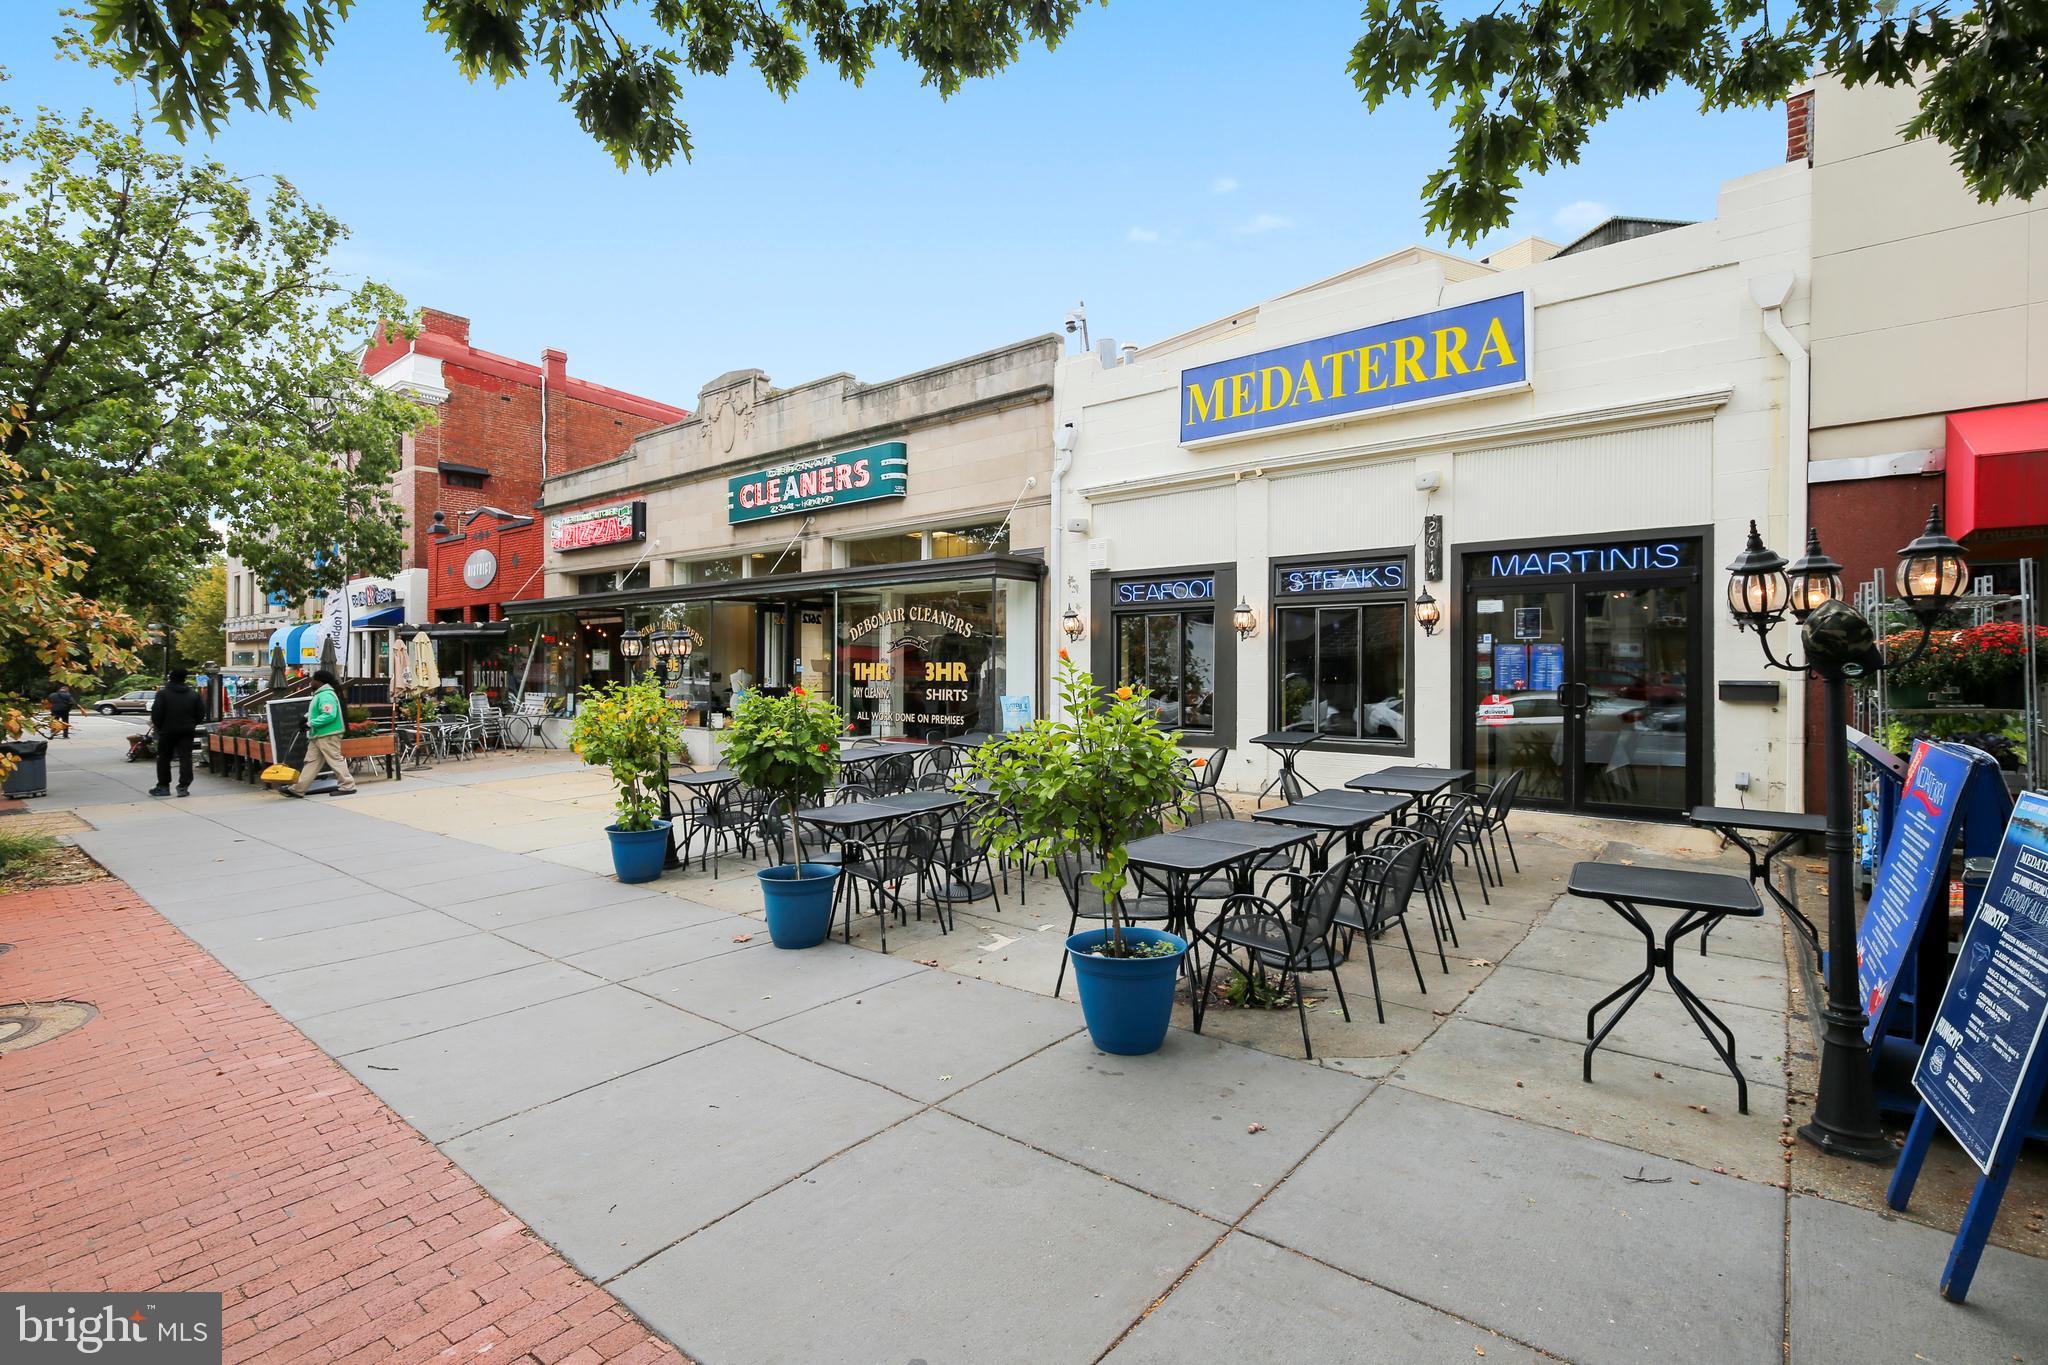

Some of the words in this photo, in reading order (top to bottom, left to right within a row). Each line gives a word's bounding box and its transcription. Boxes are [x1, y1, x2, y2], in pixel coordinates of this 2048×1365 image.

[1185, 317, 1518, 426] MEDATERRA
[740, 459, 871, 509] CLEANERS
[561, 517, 619, 549] PIZZA
[1427, 520, 1437, 577] 2614
[467, 561, 492, 577] DISTRICT
[1491, 544, 1680, 577] MARTINIS
[1288, 566, 1402, 592] STEAKS
[849, 607, 905, 642] DEBONAIR
[909, 606, 974, 638] CLEANERS
[473, 670, 508, 687] DISTRICT
[853, 662, 891, 680] 1HR
[925, 662, 968, 682] 3HR
[853, 686, 864, 698] DRY
[864, 687, 890, 699] CLEANING
[926, 688, 968, 702] SHIRTS
[857, 712, 869, 720] ALL
[871, 712, 893, 721] WORK
[895, 713, 916, 723] DONE
[918, 714, 930, 724] ON
[931, 714, 965, 726] PREMISES
[1979, 902, 2009, 933] THIRSTY?
[1999, 885, 2032, 916] EVERYDAY
[2026, 899, 2043, 922] ALL
[1934, 1015, 1964, 1054] HUNGRY?
